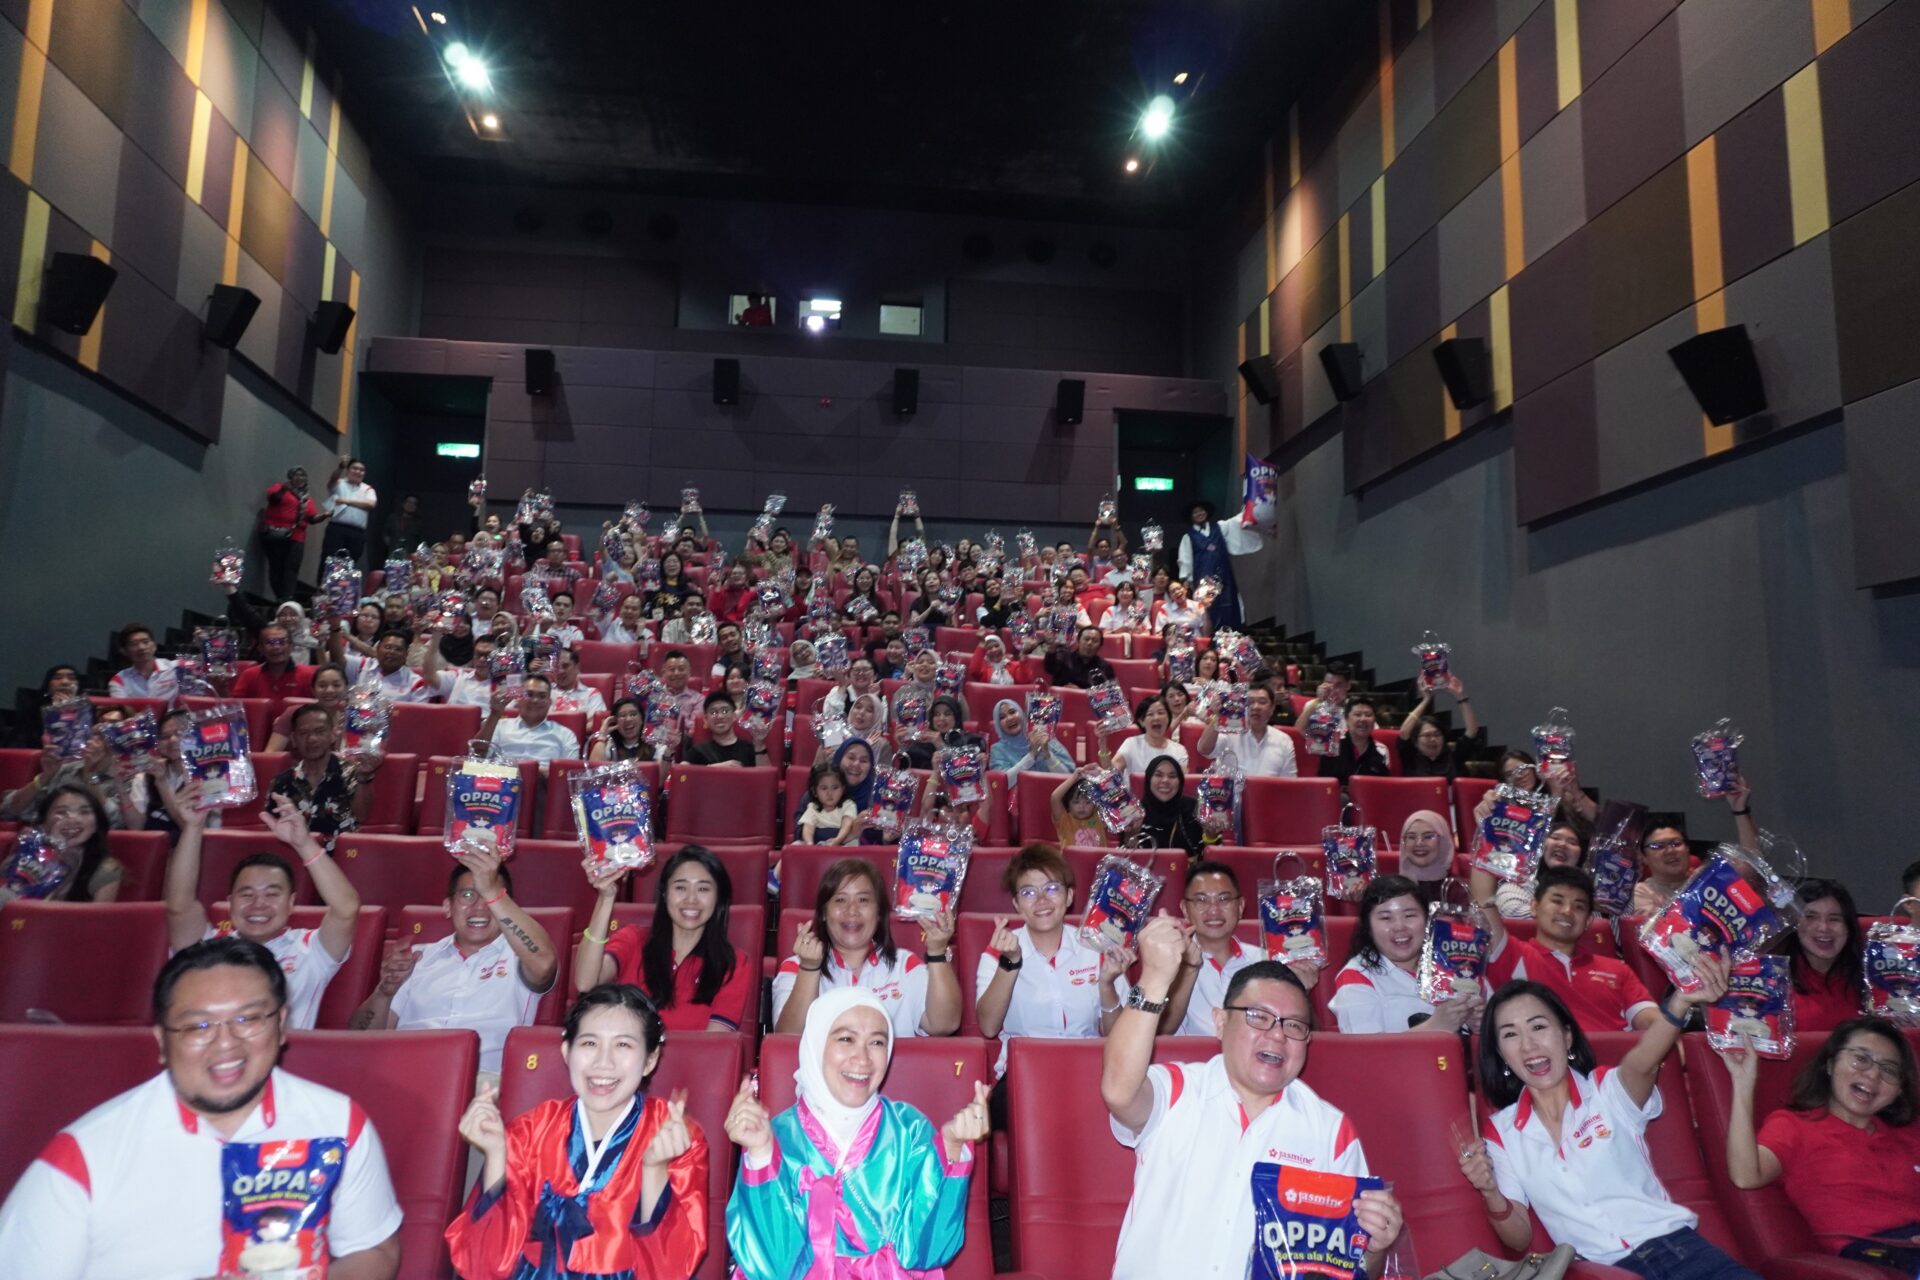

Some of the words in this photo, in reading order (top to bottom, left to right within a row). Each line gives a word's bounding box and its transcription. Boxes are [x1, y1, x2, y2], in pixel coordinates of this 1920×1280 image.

[460, 791, 501, 803] OPPA
[591, 804, 632, 820] OPPA
[1490, 817, 1526, 833] OPPA
[346, 848, 357, 859] 10
[907, 855, 945, 869] OPPA
[1703, 886, 1747, 931] OPPA
[413, 923, 421, 934] 9
[610, 920, 617, 930] 8
[1441, 941, 1478, 953] OPPA
[1728, 976, 1764, 988] PPA
[526, 1054, 537, 1070] 8
[954, 1061, 964, 1076] 7
[1437, 1056, 1448, 1071] 5
[1279, 1151, 1313, 1165] jasmine
[232, 1169, 306, 1196] OPPA
[1298, 1191, 1344, 1208] jasmine
[1263, 1221, 1346, 1255] OPPA
[1307, 1251, 1323, 1261] ala
[1326, 1253, 1355, 1269] Korea
